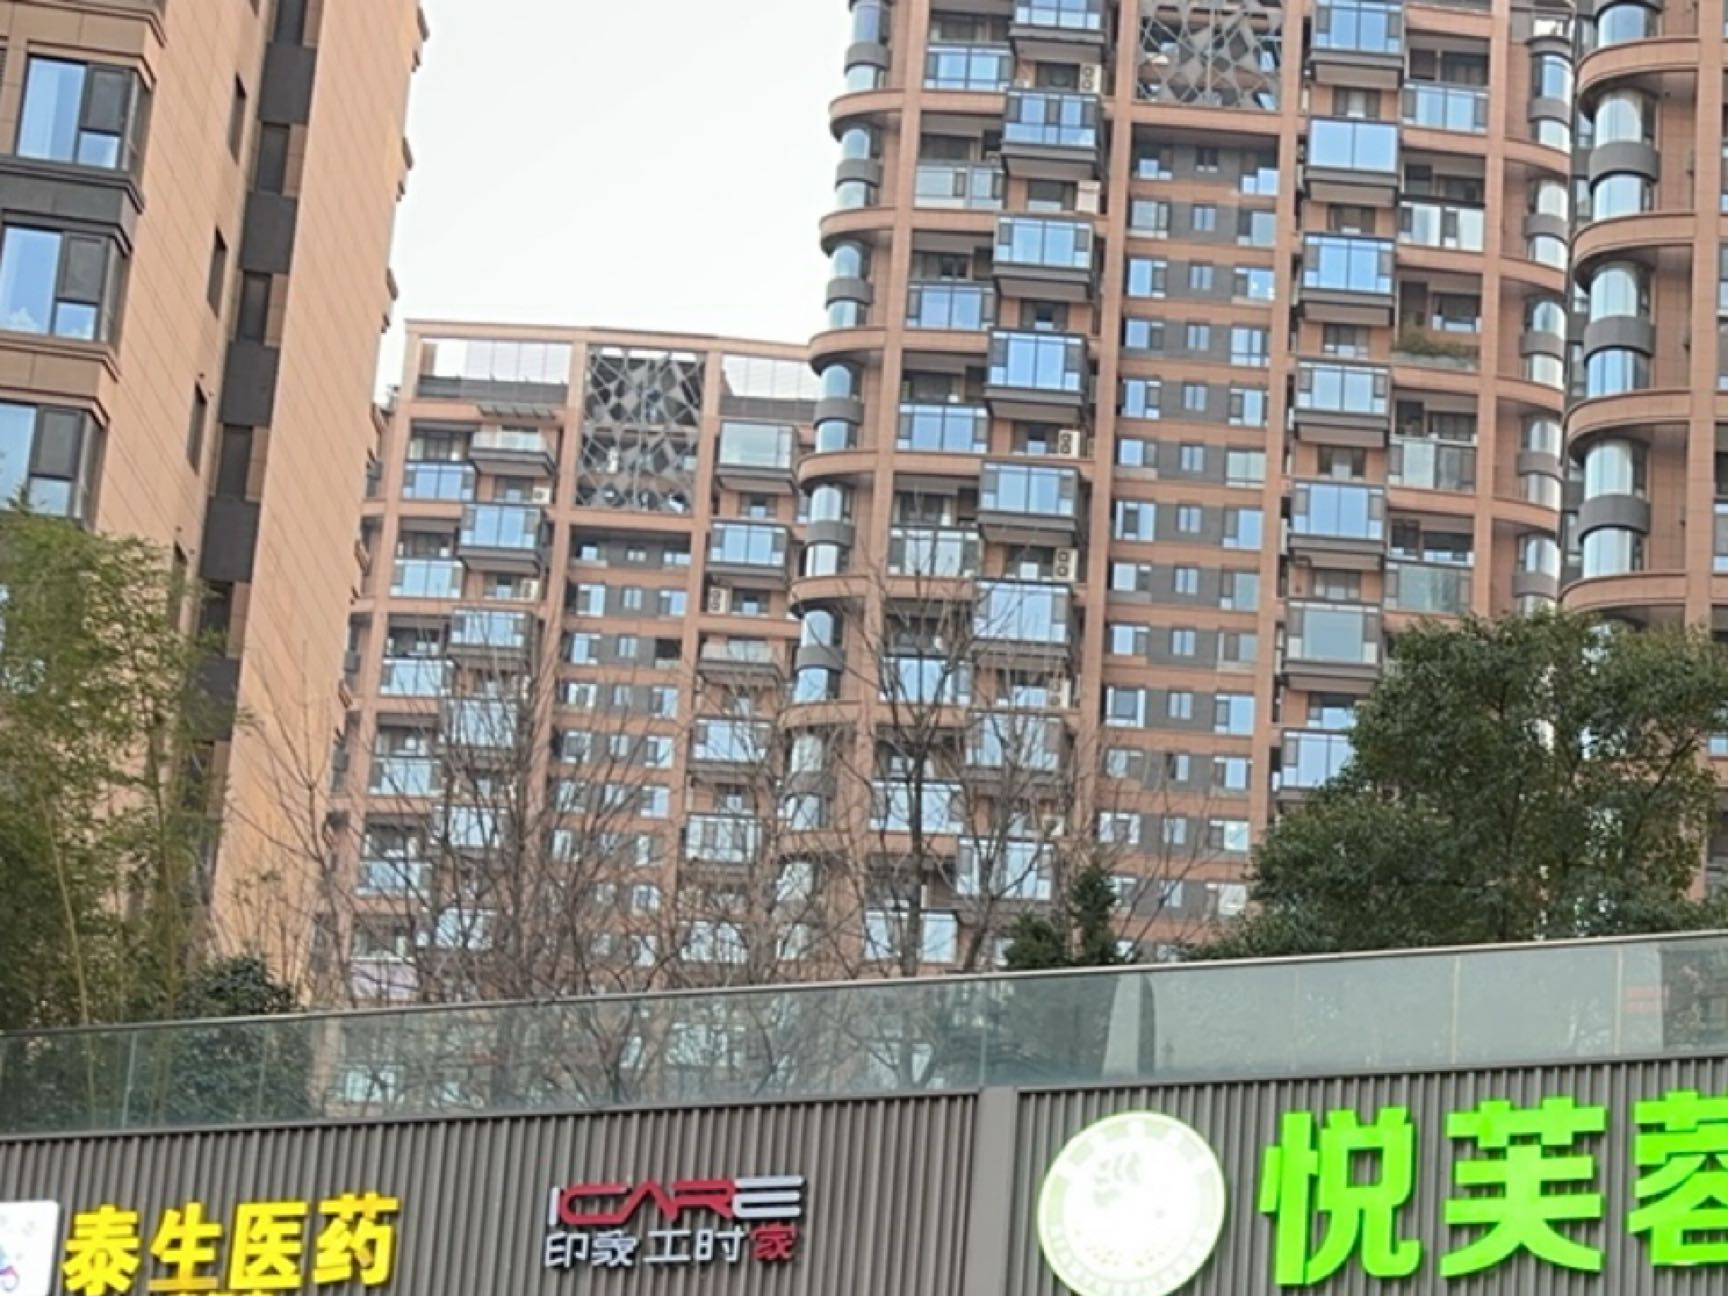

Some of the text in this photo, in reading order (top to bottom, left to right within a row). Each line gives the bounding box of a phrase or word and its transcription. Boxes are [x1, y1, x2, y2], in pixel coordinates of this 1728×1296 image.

[548, 1176, 804, 1226] ICARE
[62, 1192, 400, 1296] 泰生医药
